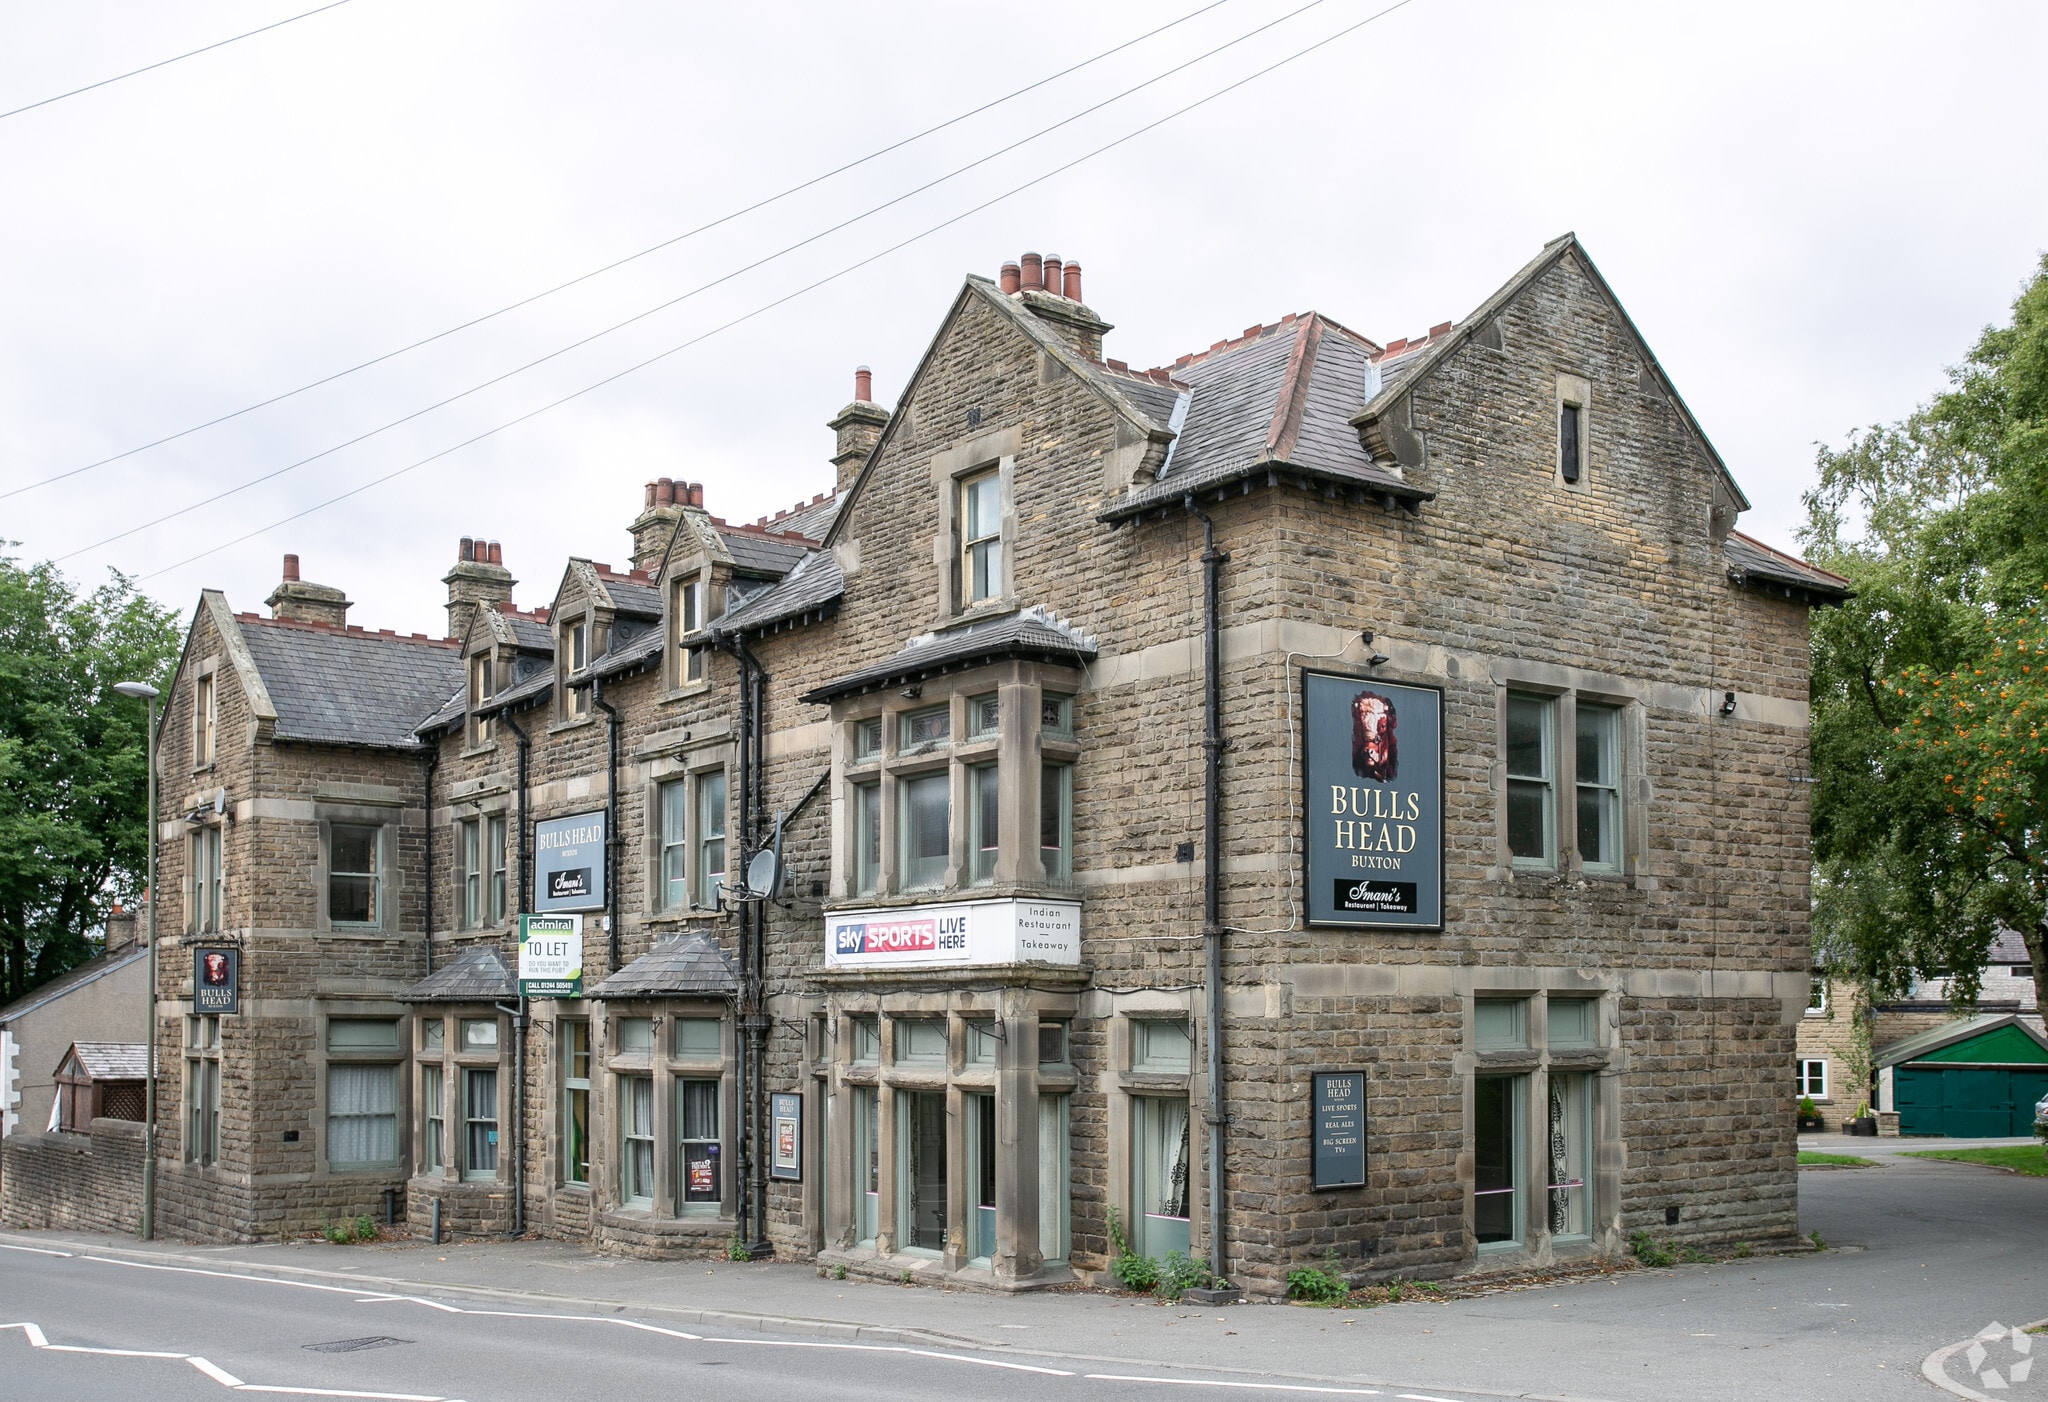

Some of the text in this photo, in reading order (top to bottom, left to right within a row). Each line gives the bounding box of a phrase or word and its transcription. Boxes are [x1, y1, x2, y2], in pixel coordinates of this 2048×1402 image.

[1330, 785, 1420, 821] BULLS
[540, 825, 602, 850] BULLS HEAD
[1334, 819, 1417, 853] HEAD
[1351, 855, 1401, 870] BUXTON
[1349, 880, 1401, 902] Imani's
[1029, 907, 1061, 917] Indian
[1344, 901, 1408, 912] Restaurant Takeaway
[530, 920, 571, 930] admiral
[939, 916, 966, 934] LIVE
[1018, 918, 1072, 930] Restaurant
[838, 924, 934, 952] sky SPORTS
[938, 934, 966, 950] HERE
[527, 942, 568, 956] TO LET
[1021, 939, 1069, 952] Takeaway
[1326, 1079, 1352, 1089] BULLS
[1327, 1088, 1351, 1098] HEAD
[779, 1105, 794, 1113] HEAD
